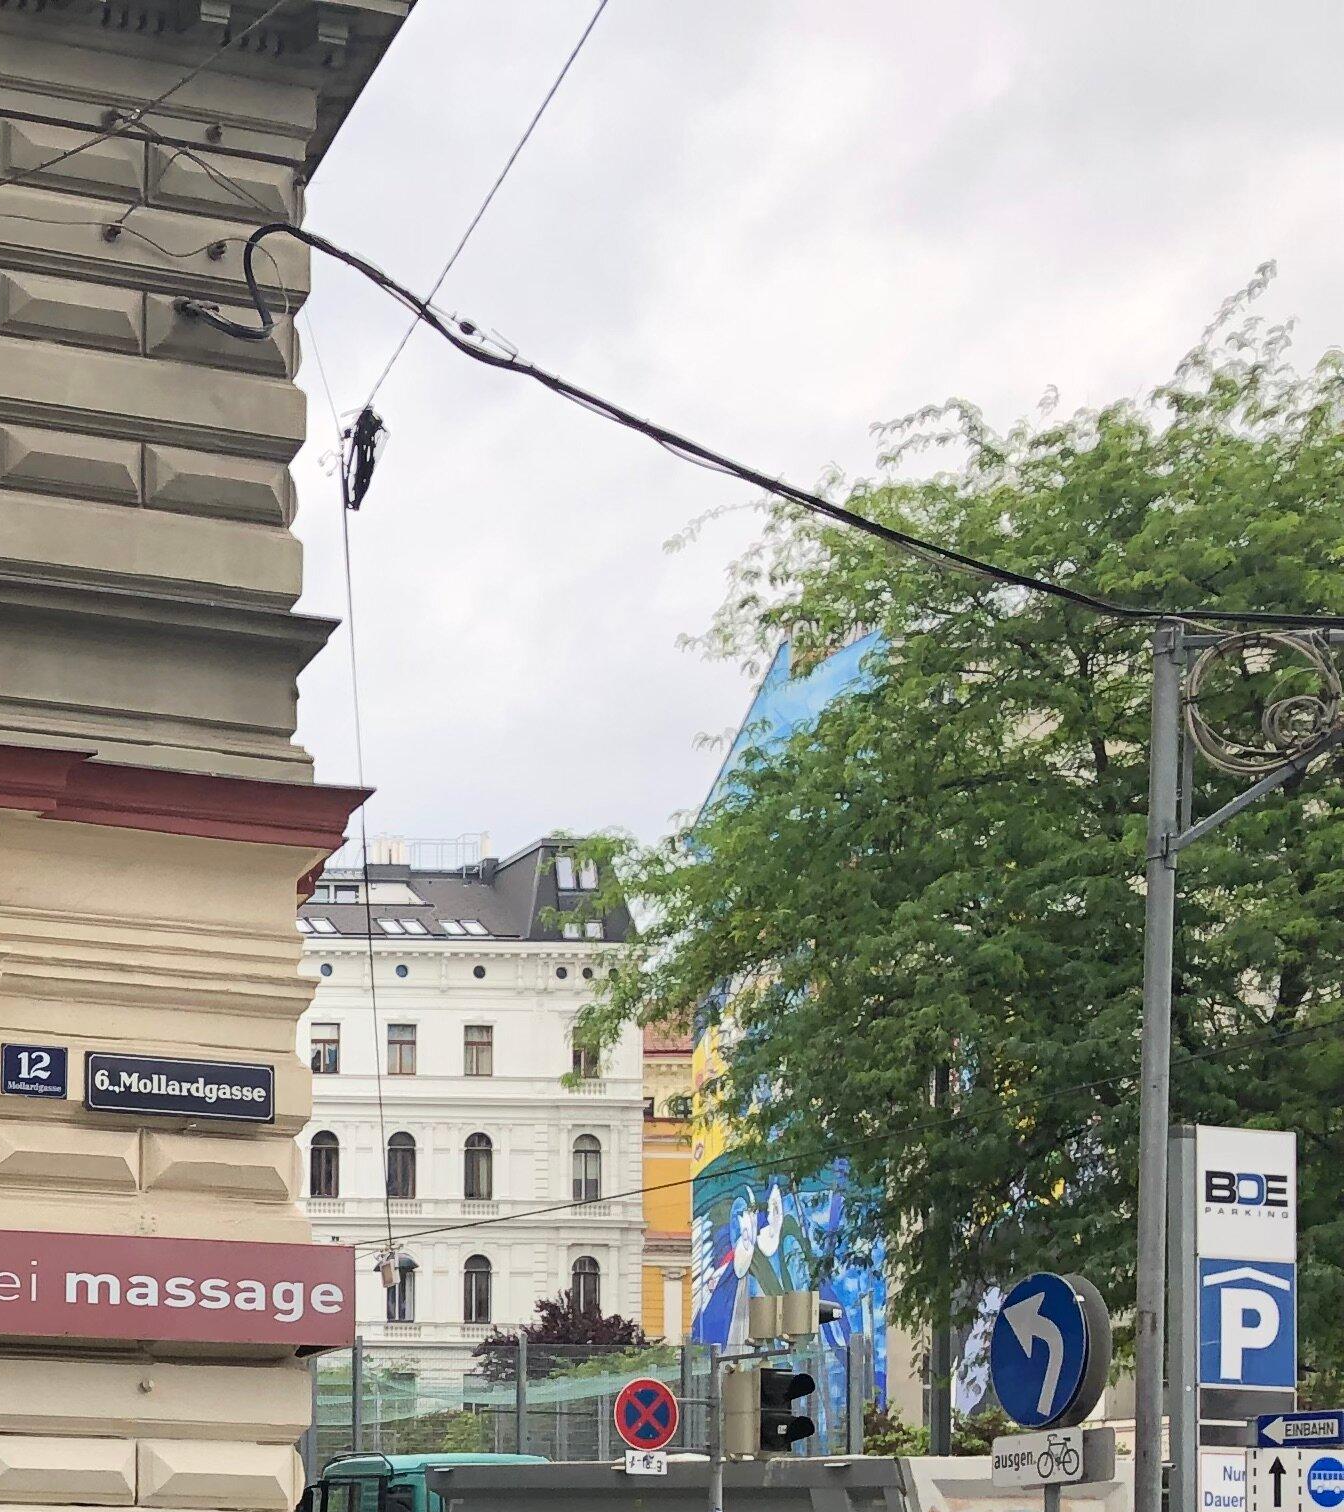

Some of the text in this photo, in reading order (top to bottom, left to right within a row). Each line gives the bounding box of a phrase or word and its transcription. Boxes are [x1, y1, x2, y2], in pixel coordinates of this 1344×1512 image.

[17, 1051, 52, 1080] 12
[1204, 1206, 1289, 1219] PARKING
[65, 1265, 345, 1324] massage
[1220, 1288, 1280, 1380] P
[1284, 1421, 1334, 1437] EINBAHN
